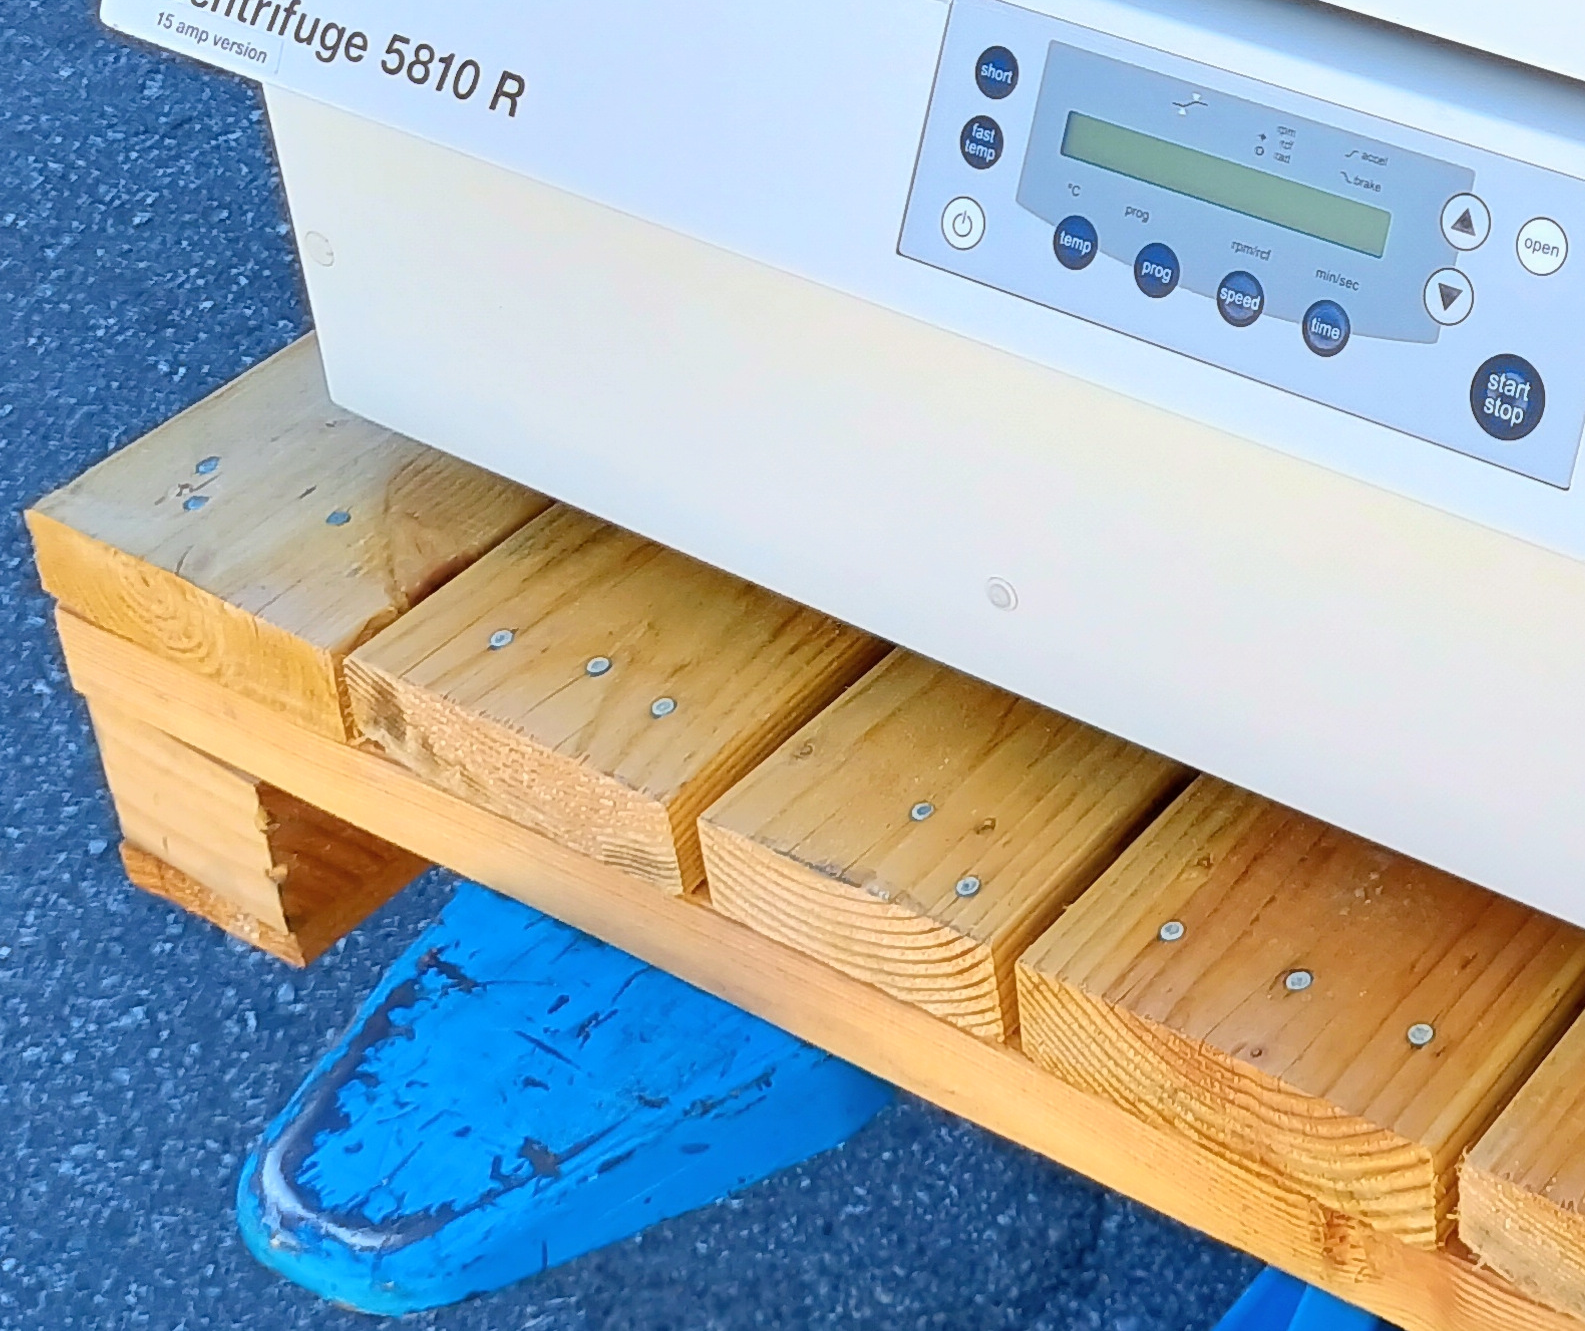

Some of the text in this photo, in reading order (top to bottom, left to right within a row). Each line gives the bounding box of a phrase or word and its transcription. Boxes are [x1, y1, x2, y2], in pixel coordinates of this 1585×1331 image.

[157, 11, 268, 64] 15 amp version
[381, 33, 481, 101] 5810
[488, 70, 525, 118] R
[981, 63, 1013, 84] short
[972, 123, 996, 143] fast
[964, 139, 996, 162] temp
[1353, 174, 1382, 192] brake
[1124, 204, 1150, 222] prog
[1060, 230, 1092, 255] temp
[1524, 237, 1560, 258] open
[1142, 260, 1172, 284] prog
[1315, 269, 1360, 291] min/sec
[1220, 287, 1261, 312] speed
[1310, 317, 1341, 340] time
[1487, 371, 1531, 401] start
[1483, 395, 1524, 427] stop
